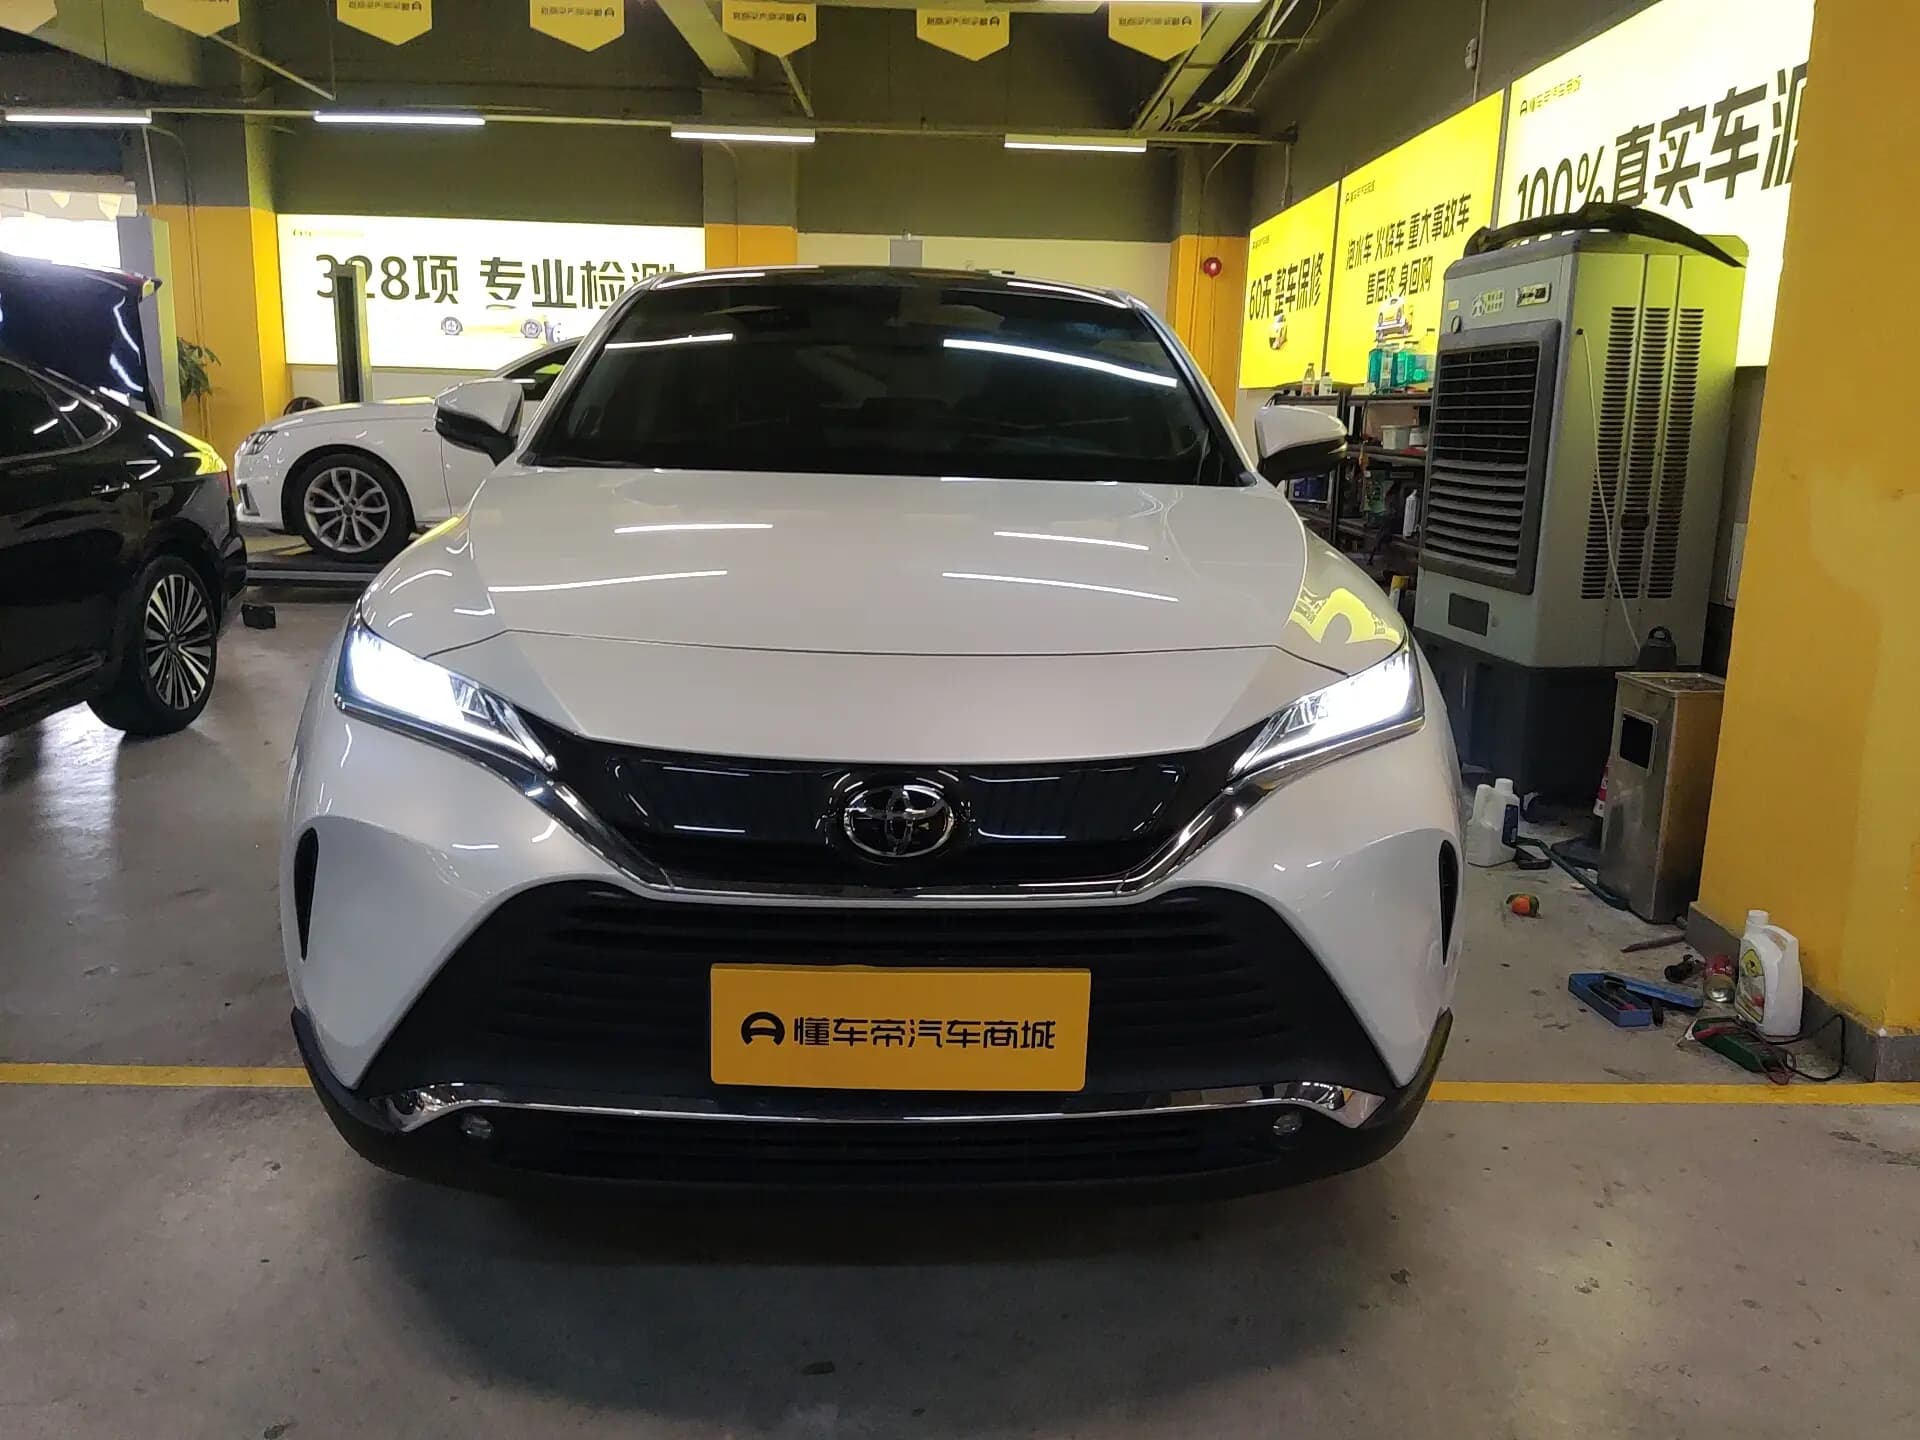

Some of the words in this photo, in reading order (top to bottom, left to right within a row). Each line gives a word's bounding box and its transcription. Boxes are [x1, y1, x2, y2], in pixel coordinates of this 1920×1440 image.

[1374, 220, 1406, 261] 火烧车
[1408, 194, 1472, 250] 重大事故车
[316, 254, 459, 304] 328项
[1249, 273, 1273, 321] 60天
[1273, 252, 1324, 317] 整车保修
[794, 1016, 1056, 1050] 懂车帝汽车商城
